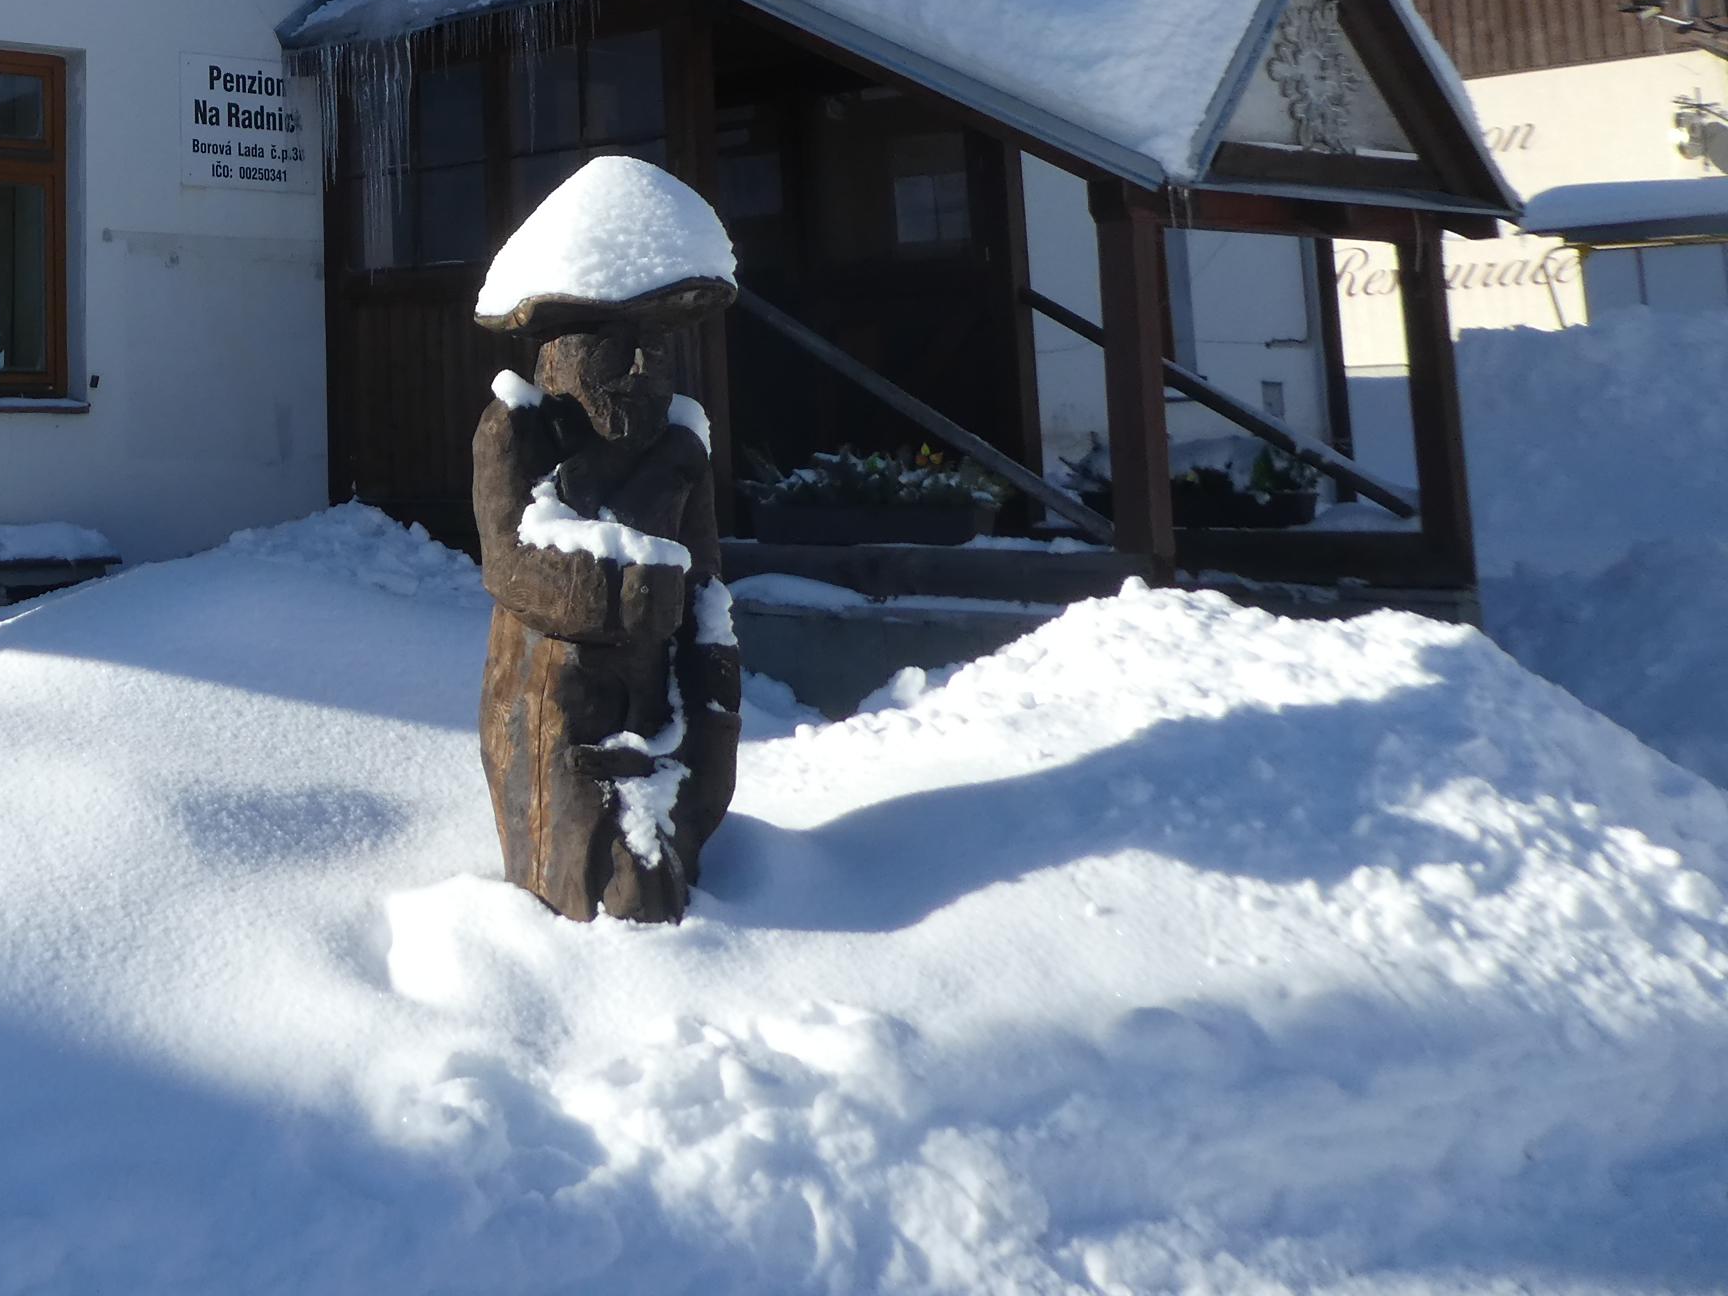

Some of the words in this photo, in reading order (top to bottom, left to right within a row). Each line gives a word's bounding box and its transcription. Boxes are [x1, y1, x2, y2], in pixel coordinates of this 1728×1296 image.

[208, 65, 286, 97] Penzion
[194, 98, 220, 127] Na
[192, 138, 232, 156] Borová
[238, 142, 265, 158] Lada
[211, 160, 233, 179] IČO:
[239, 166, 287, 182] 00250341
